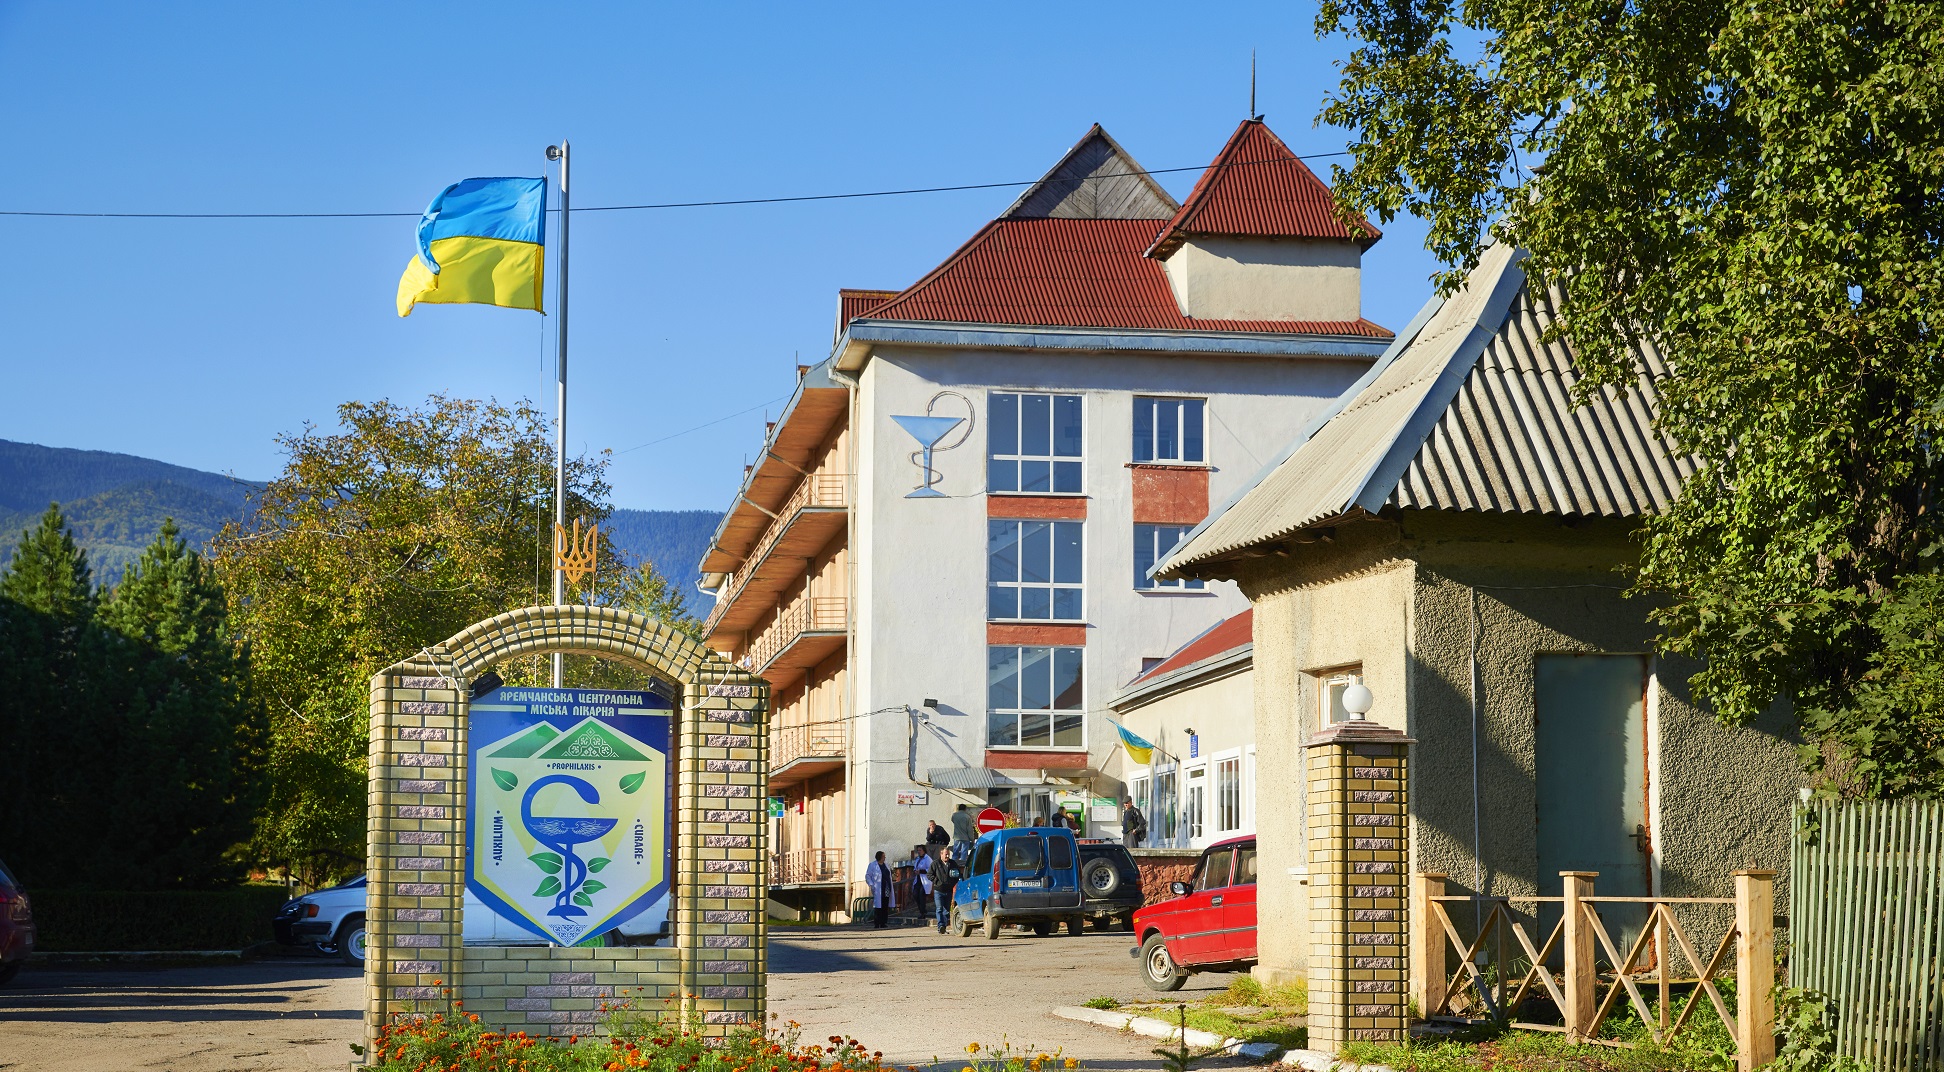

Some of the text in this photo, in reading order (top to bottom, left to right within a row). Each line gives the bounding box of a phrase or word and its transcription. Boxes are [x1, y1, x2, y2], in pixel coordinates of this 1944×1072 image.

[500, 691, 643, 705] ЯРЕМЧАНСЬКА ЦЕНТРАЛЬНА
[530, 704, 615, 717] МІСЬКА ЛІКАРНЯ
[552, 762, 596, 771] PROPHILAXIS
[493, 816, 503, 862] AUXILIUM
[634, 824, 644, 859] CURARE
